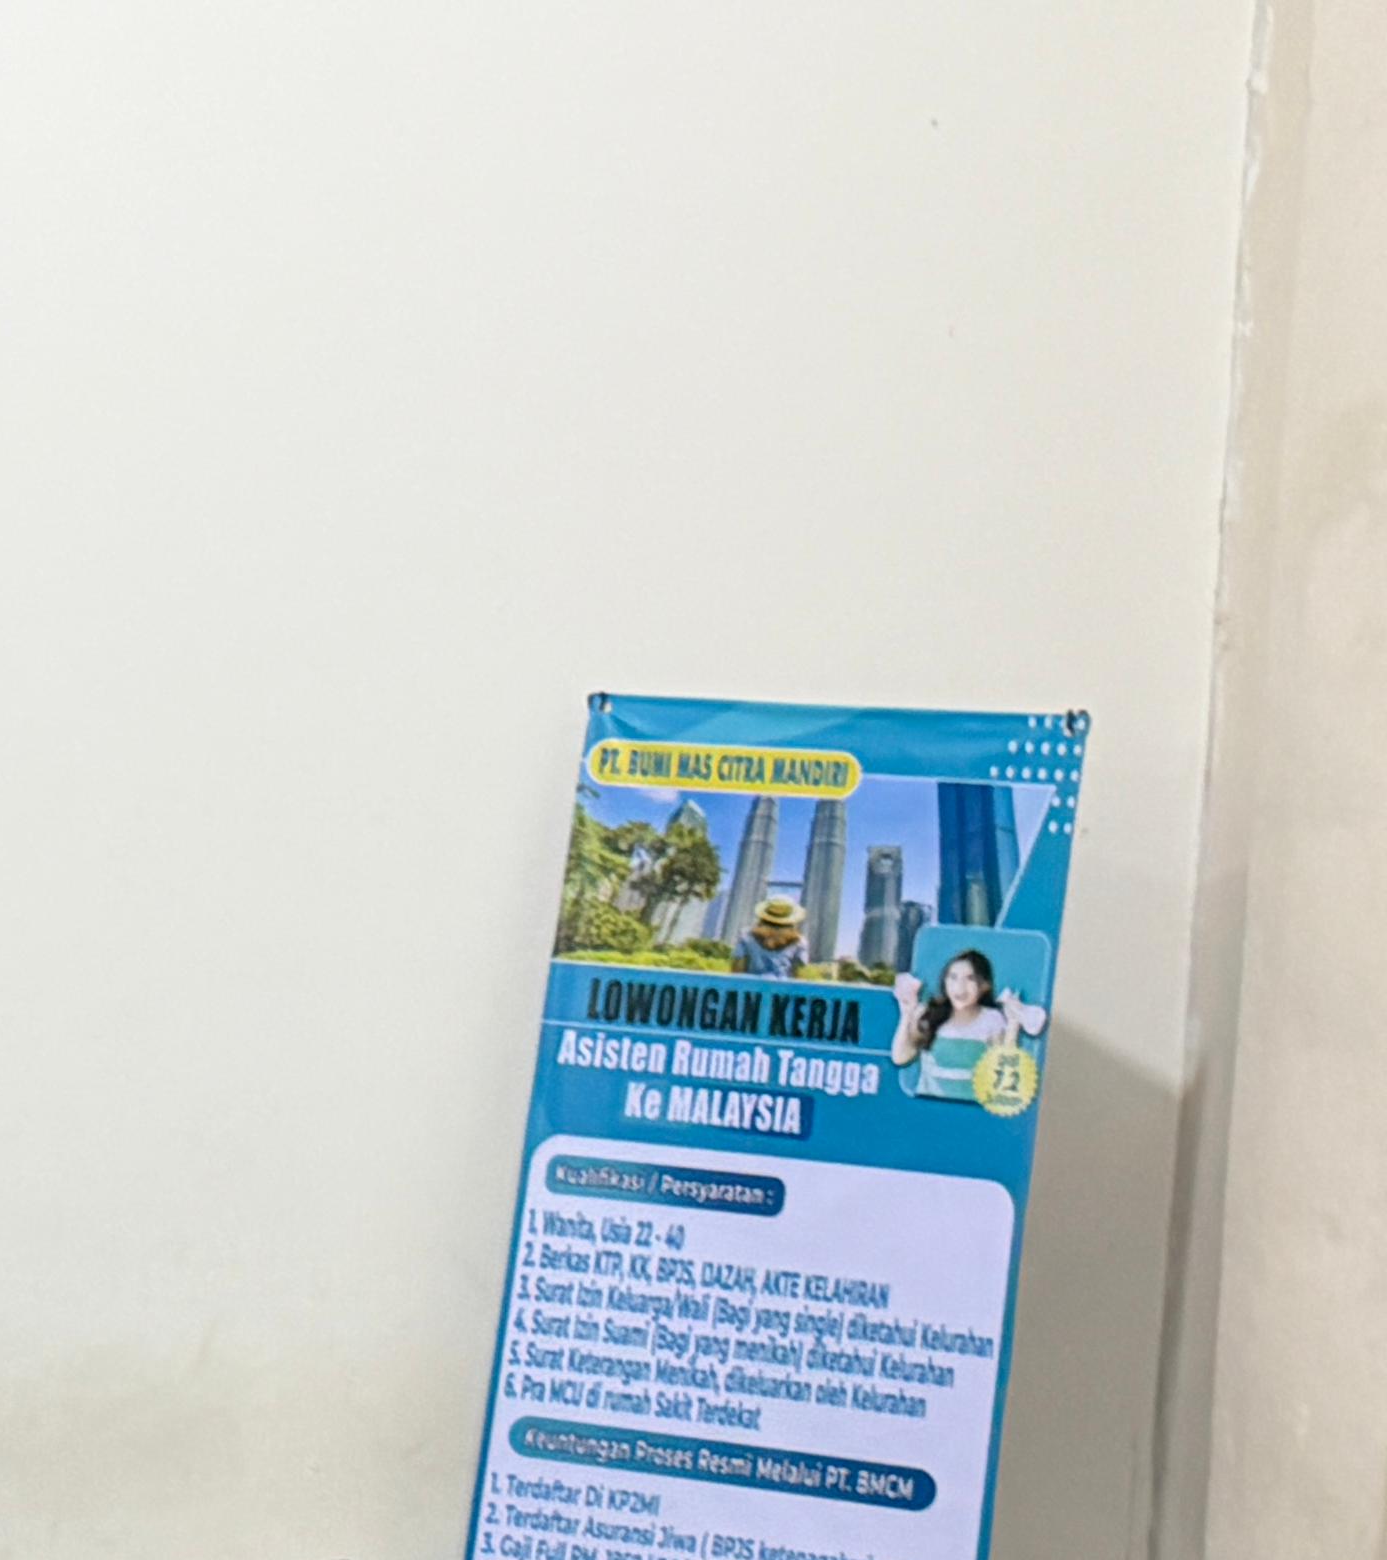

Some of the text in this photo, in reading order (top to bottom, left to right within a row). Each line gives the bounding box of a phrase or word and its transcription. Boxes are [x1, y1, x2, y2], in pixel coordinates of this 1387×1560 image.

[598, 747, 849, 787] PT. BUMI MAS CITRA MANDIRI
[588, 978, 859, 1044] LOWONGAN KERJA
[558, 1030, 880, 1097] Asisten Rumah Tangga
[625, 1082, 801, 1135] Ke MALAYSIA
[601, 1216, 631, 1244] Usia
[634, 1220, 653, 1248] 22
[521, 1240, 536, 1268] 2.
[540, 1244, 589, 1272] Berkas
[761, 1269, 800, 1298] AKTE
[804, 1274, 890, 1309] KELAHIRAN
[513, 1306, 528, 1334] 4.
[532, 1309, 571, 1338] Surat
[603, 1318, 650, 1349] Suami
[881, 1353, 955, 1389] Kelurahan
[516, 1273, 531, 1301] 3.
[535, 1276, 574, 1304] Surat
[920, 1322, 994, 1360] Kelurahan
[507, 1339, 522, 1367] 5.
[526, 1341, 565, 1370] Surat
[568, 1346, 652, 1386] Keterangan
[851, 1383, 926, 1419] Kelurahan
[549, 1378, 585, 1406] MCU
[604, 1388, 652, 1415] rumah
[655, 1392, 694, 1422] Sakit
[696, 1397, 762, 1431] Terdekat
[507, 1473, 581, 1506] Terdaftar
[584, 1484, 604, 1509] Di
[608, 1490, 661, 1517] KP2MI
[525, 1428, 914, 1501] Keuntungan Proses Resmi Melalui PT. BMCM
[480, 1531, 495, 1555] 3.
[484, 1501, 500, 1525] 2.
[507, 1504, 579, 1536] Terdaftar
[583, 1517, 656, 1547] Asuransi
[658, 1526, 697, 1552] Jiwa
[711, 1534, 754, 1560] BPJS
